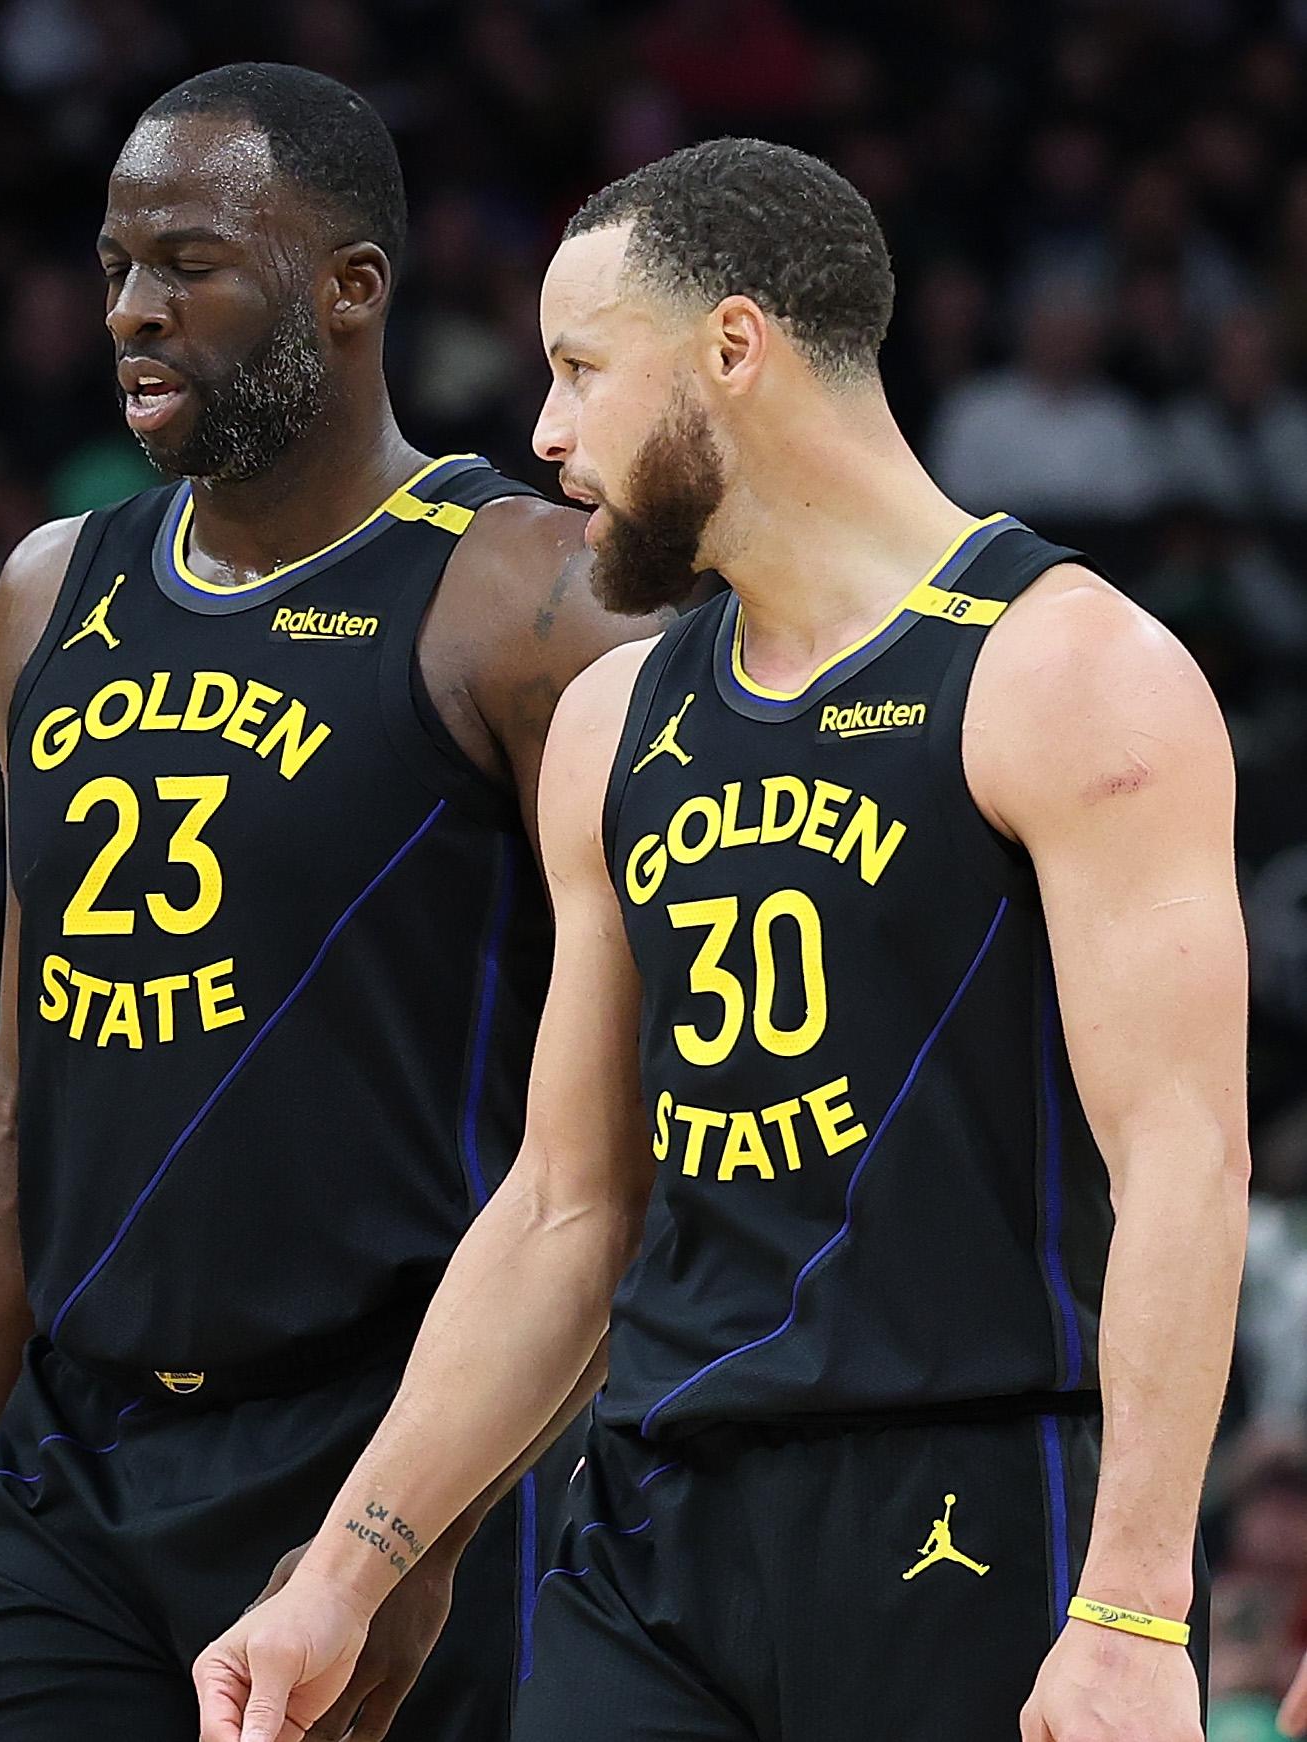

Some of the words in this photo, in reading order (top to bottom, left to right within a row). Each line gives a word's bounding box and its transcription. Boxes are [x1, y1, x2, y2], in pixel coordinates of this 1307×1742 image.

[271, 606, 379, 637] Rakuten
[942, 596, 972, 618] 16
[31, 672, 332, 780] GOLDEN
[818, 700, 927, 733] Rakuten
[64, 775, 229, 936] 23
[626, 775, 908, 905] GOLDEN
[39, 953, 246, 1050] STATE
[667, 889, 827, 1066] 30
[652, 1076, 868, 1181] STATE
